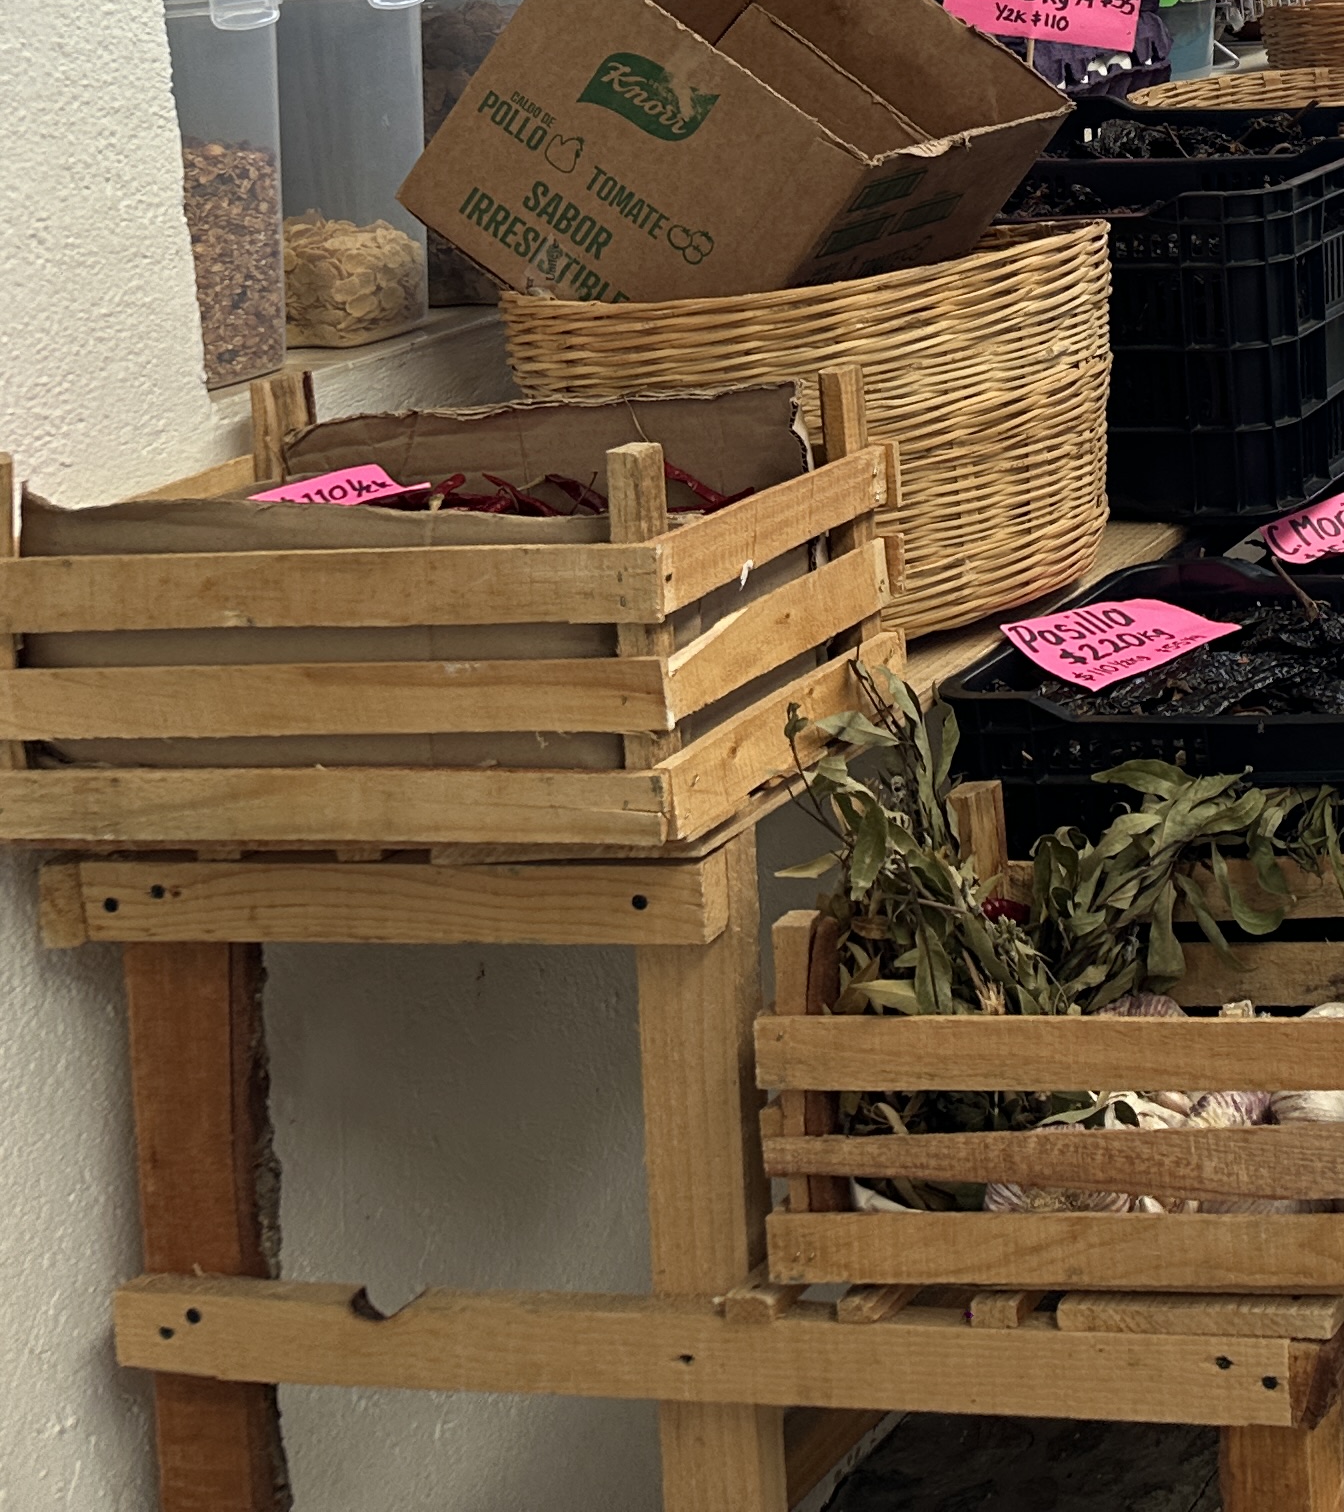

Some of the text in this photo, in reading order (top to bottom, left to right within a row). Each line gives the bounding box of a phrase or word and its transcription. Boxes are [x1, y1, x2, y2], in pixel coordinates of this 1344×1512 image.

[1030, 10, 1069, 32] $110
[477, 90, 550, 151] POLLO
[510, 91, 557, 129] CALDO DE
[600, 61, 688, 135] Knorr
[522, 180, 614, 261] SABOR
[586, 165, 670, 240] TOMATE
[1007, 607, 1136, 654] Pasilla
